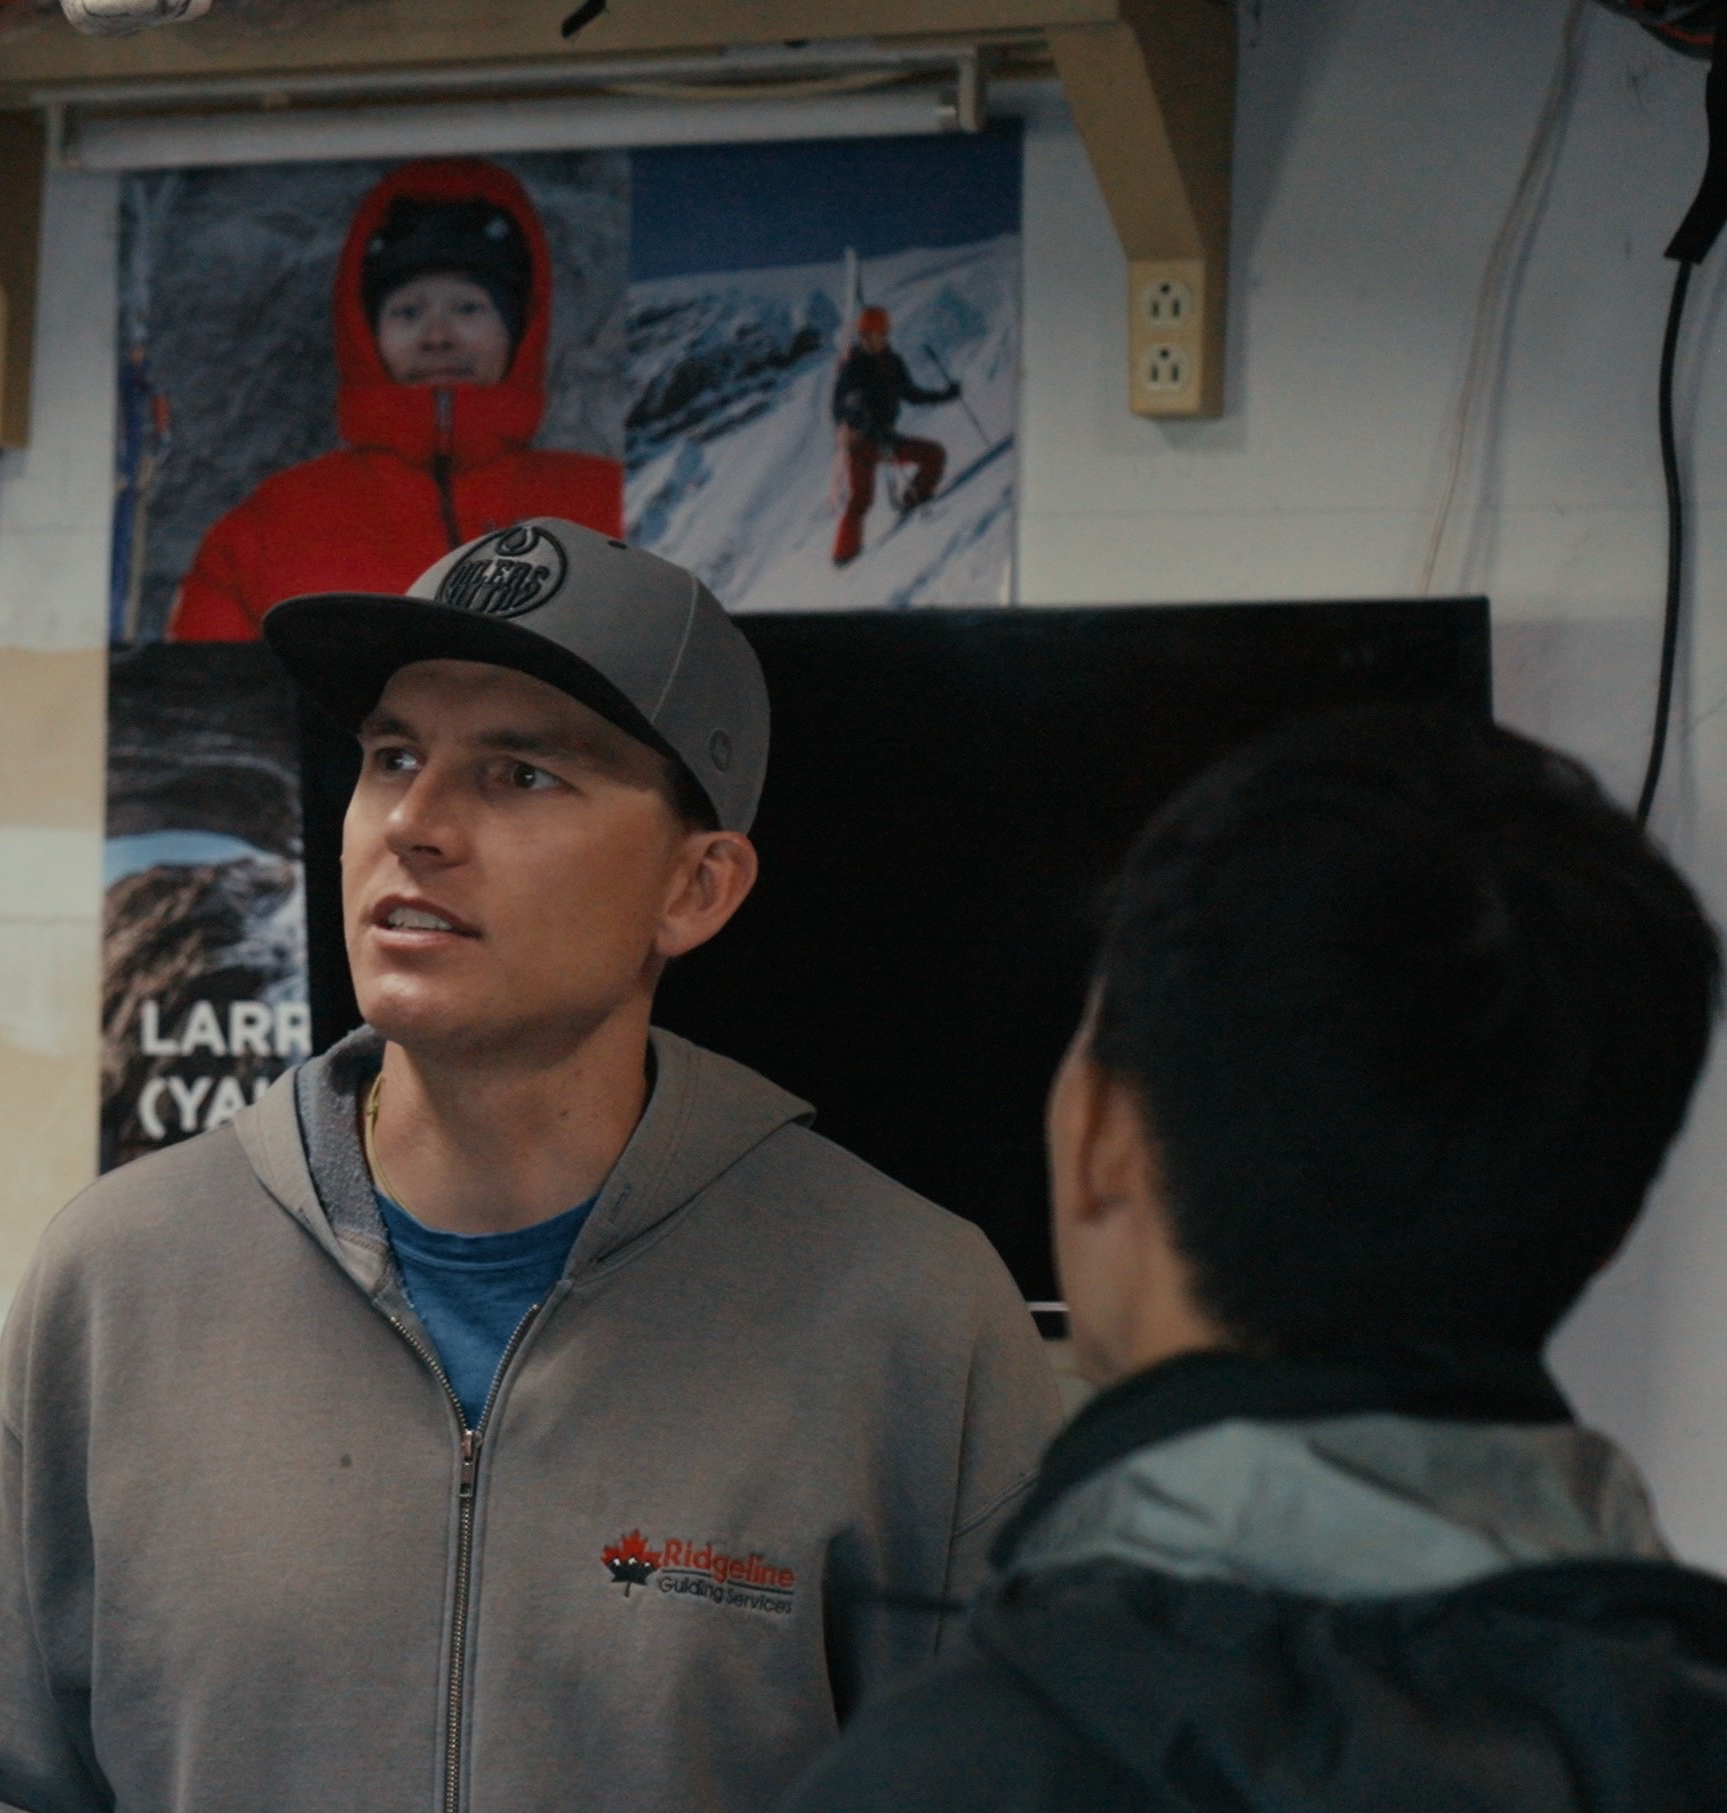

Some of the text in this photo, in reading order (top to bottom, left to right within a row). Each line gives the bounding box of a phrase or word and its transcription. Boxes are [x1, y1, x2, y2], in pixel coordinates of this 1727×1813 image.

[137, 1075, 270, 1140] (YA
[663, 1538, 796, 1588] Ridgeline
[659, 1575, 793, 1615] Guiding Services
